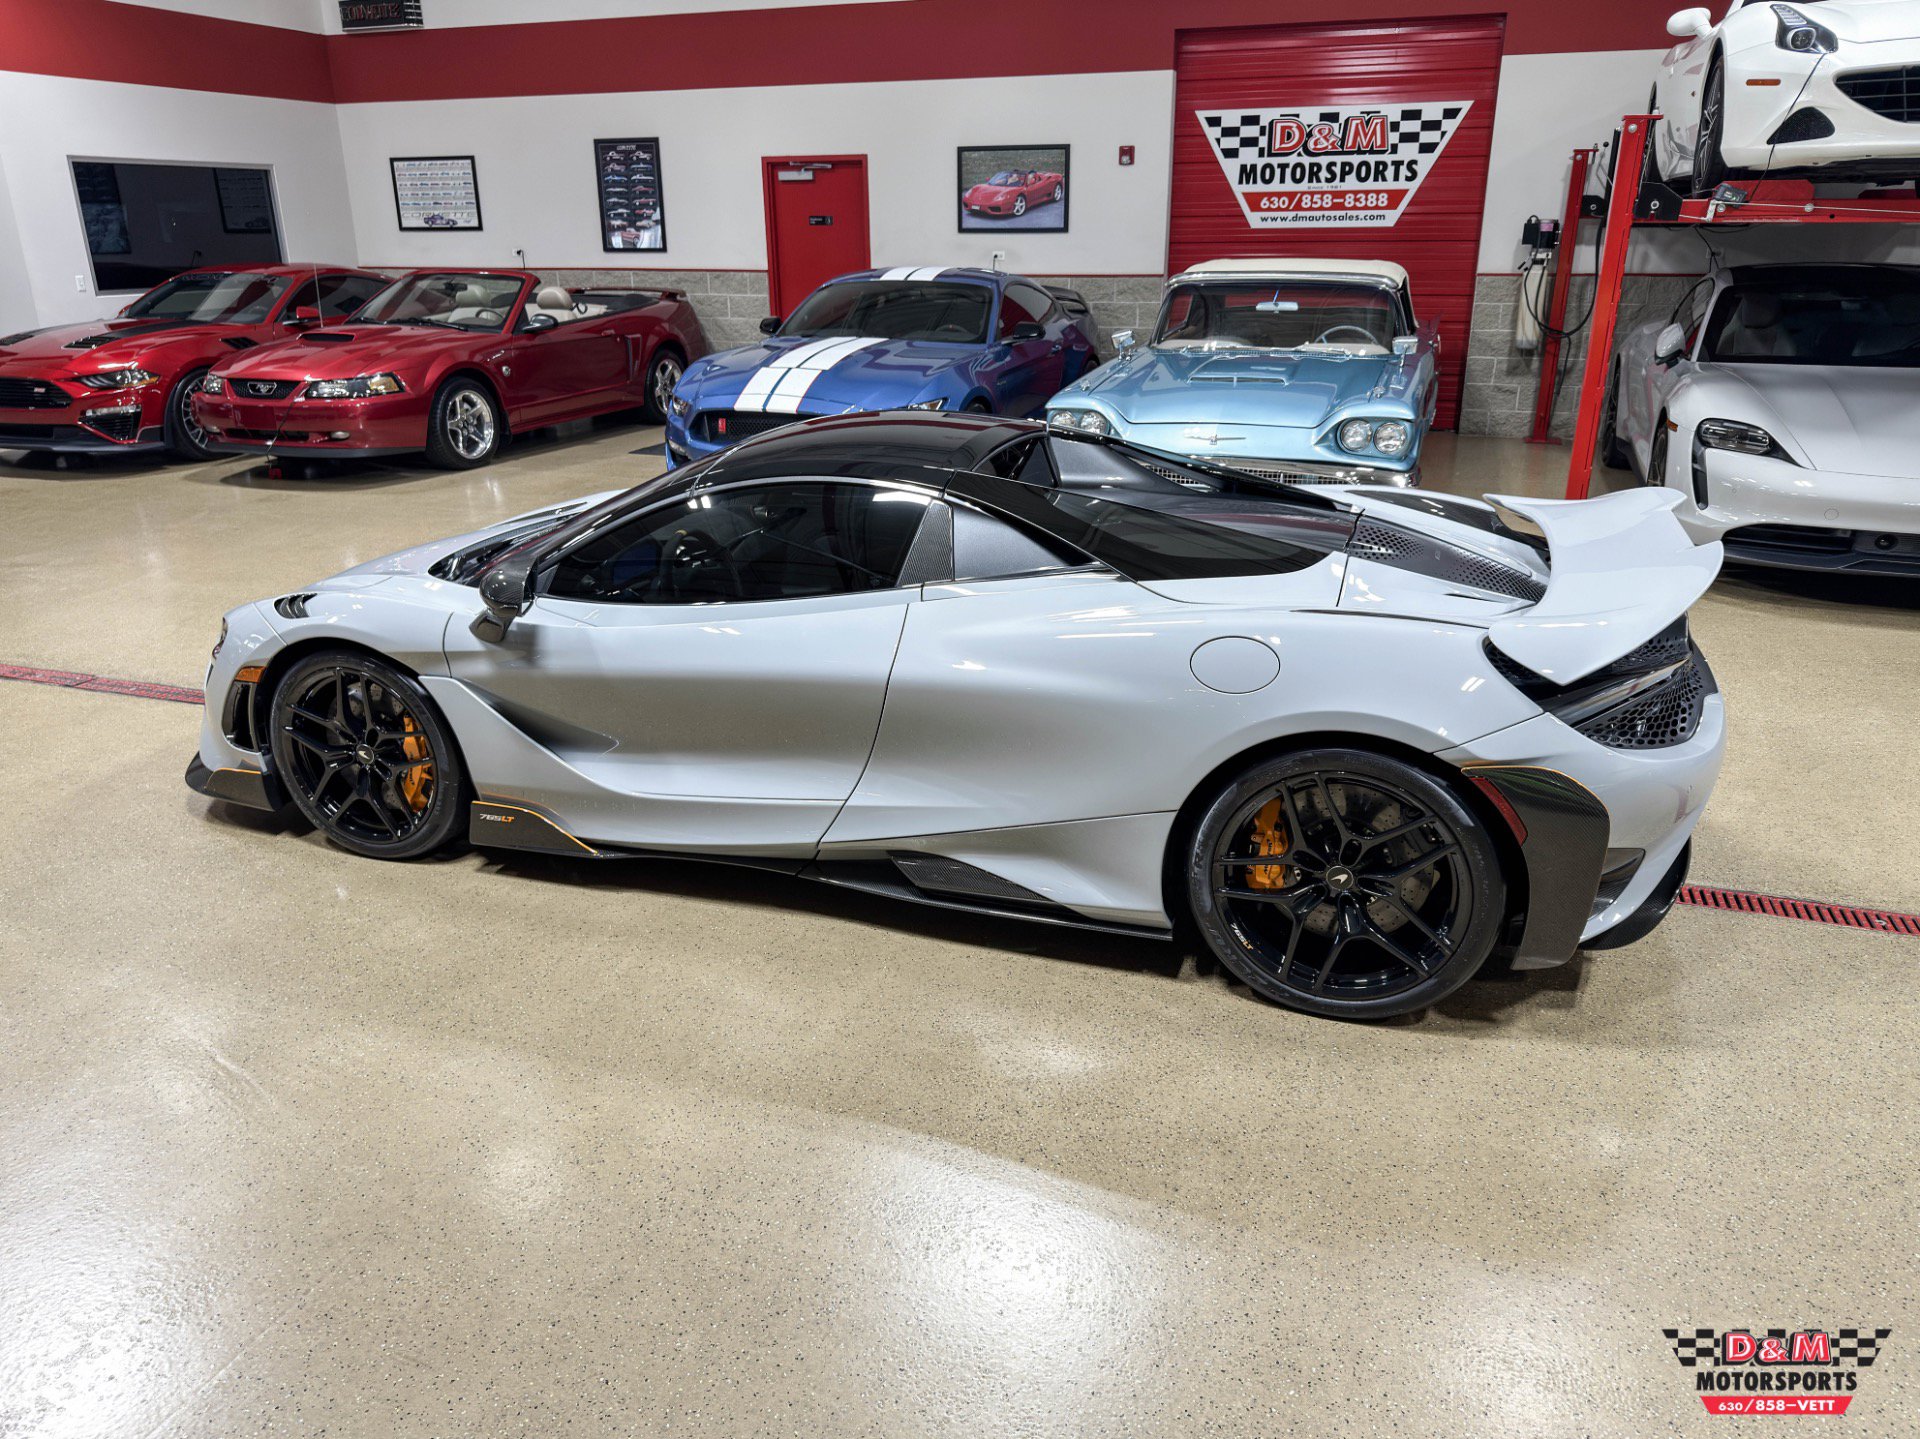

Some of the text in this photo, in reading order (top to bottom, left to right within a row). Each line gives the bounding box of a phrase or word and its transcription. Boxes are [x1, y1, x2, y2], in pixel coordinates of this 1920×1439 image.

[1269, 114, 1390, 155] D&M
[1237, 159, 1419, 186] MOTORSPORTS
[1259, 192, 1389, 210] 630/858-8388
[1259, 211, 1387, 223] www.dmautosales.com
[479, 813, 515, 823] 765LT
[1230, 922, 1254, 950] 765LT
